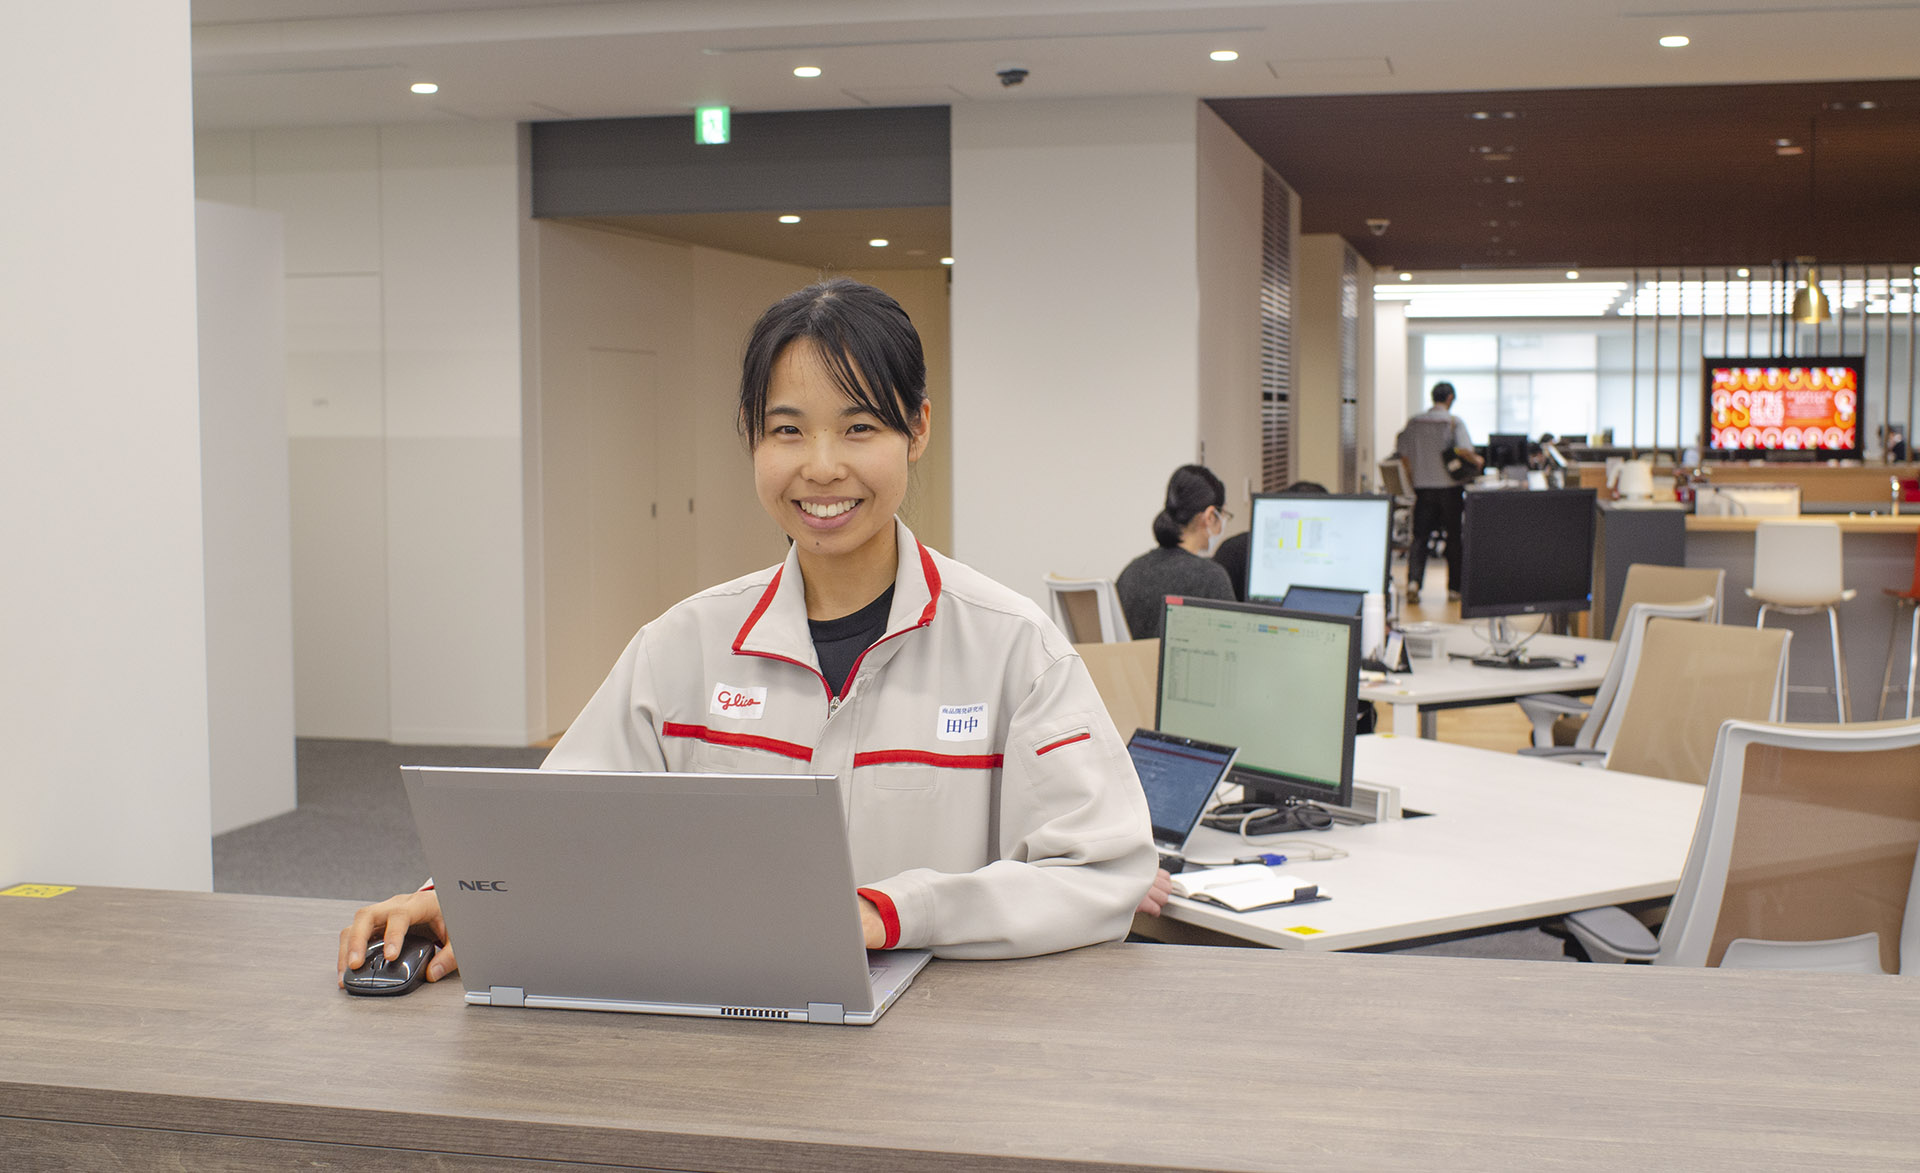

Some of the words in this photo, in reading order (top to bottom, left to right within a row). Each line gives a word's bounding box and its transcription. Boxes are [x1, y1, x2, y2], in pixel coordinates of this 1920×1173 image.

[718, 691, 761, 710] Glico
[946, 716, 978, 733] 田中
[458, 880, 508, 892] NEC
